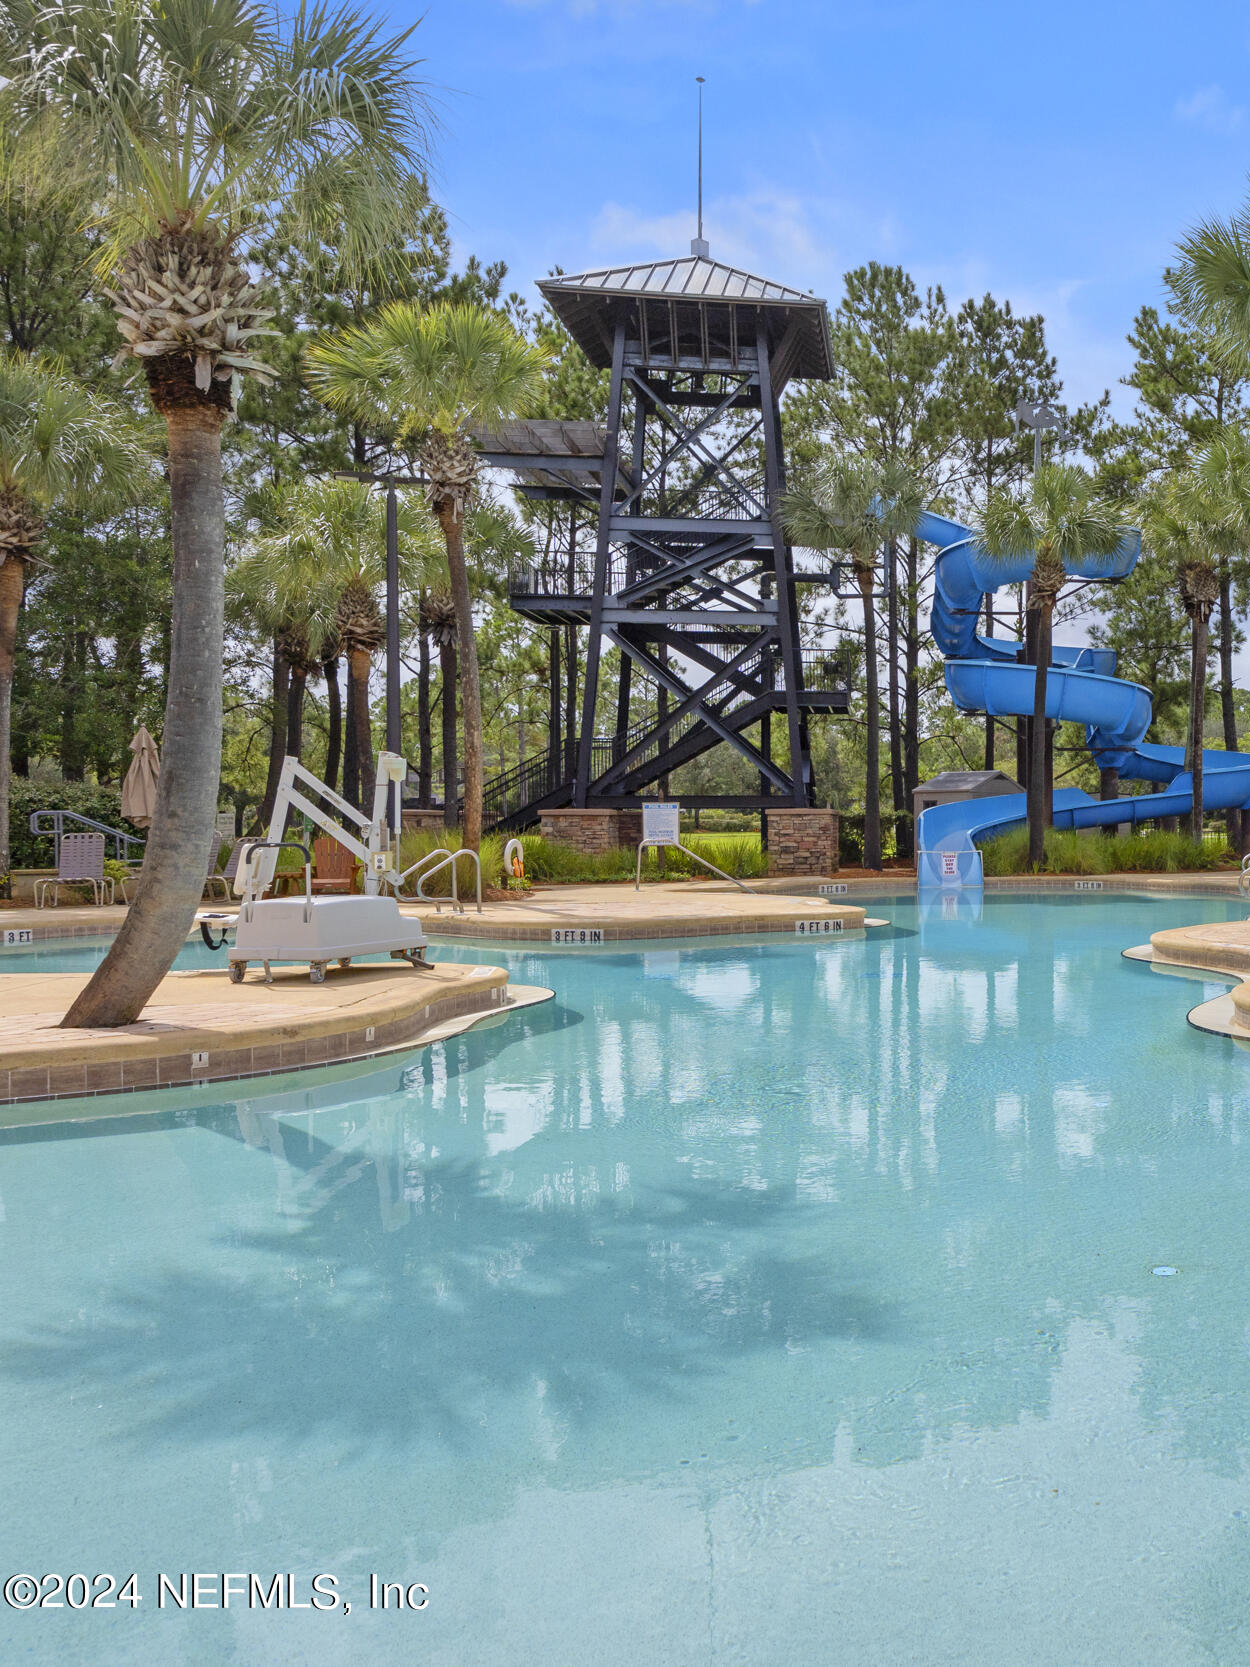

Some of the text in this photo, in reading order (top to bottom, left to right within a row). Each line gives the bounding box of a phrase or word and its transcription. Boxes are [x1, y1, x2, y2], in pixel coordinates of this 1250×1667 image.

[809, 921, 820, 931] FT
[8, 931, 15, 942] 3
[564, 931, 576, 942] FT
[590, 931, 601, 942] IN
